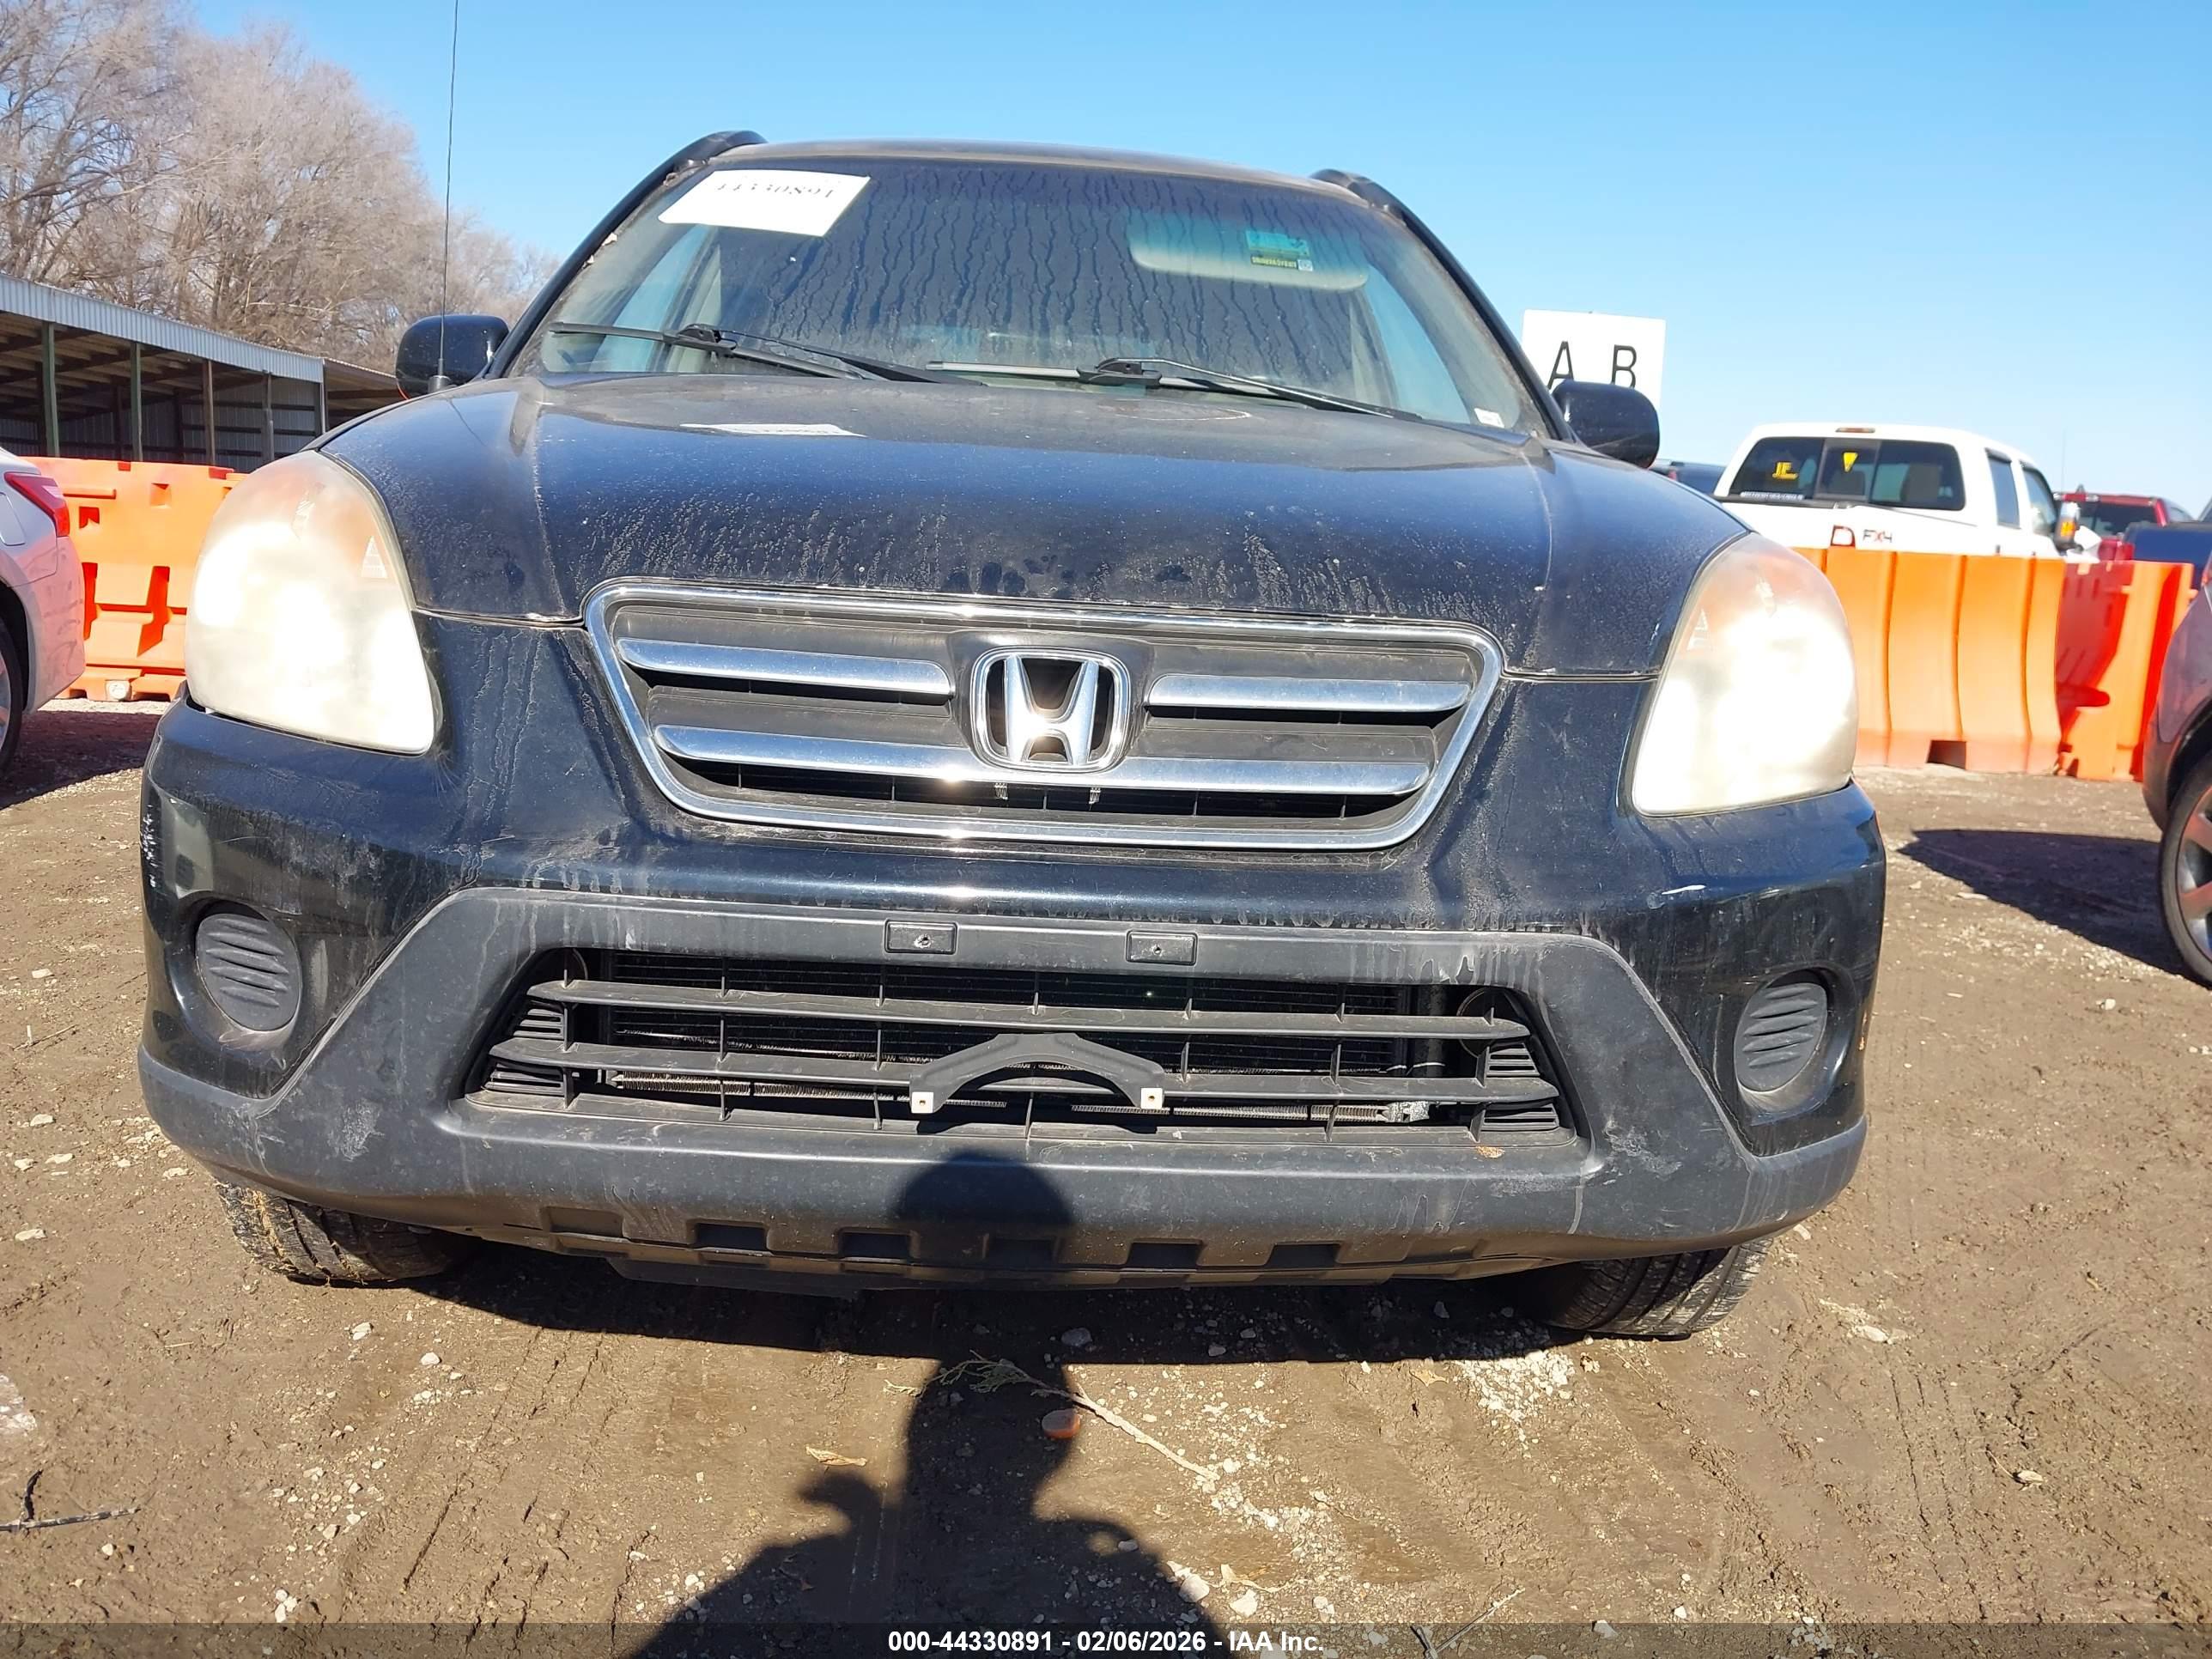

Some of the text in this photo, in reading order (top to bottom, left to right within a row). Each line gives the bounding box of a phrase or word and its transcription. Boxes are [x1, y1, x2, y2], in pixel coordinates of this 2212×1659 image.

[1547, 340, 1638, 390] A B
[1863, 528, 1893, 543] FX4
